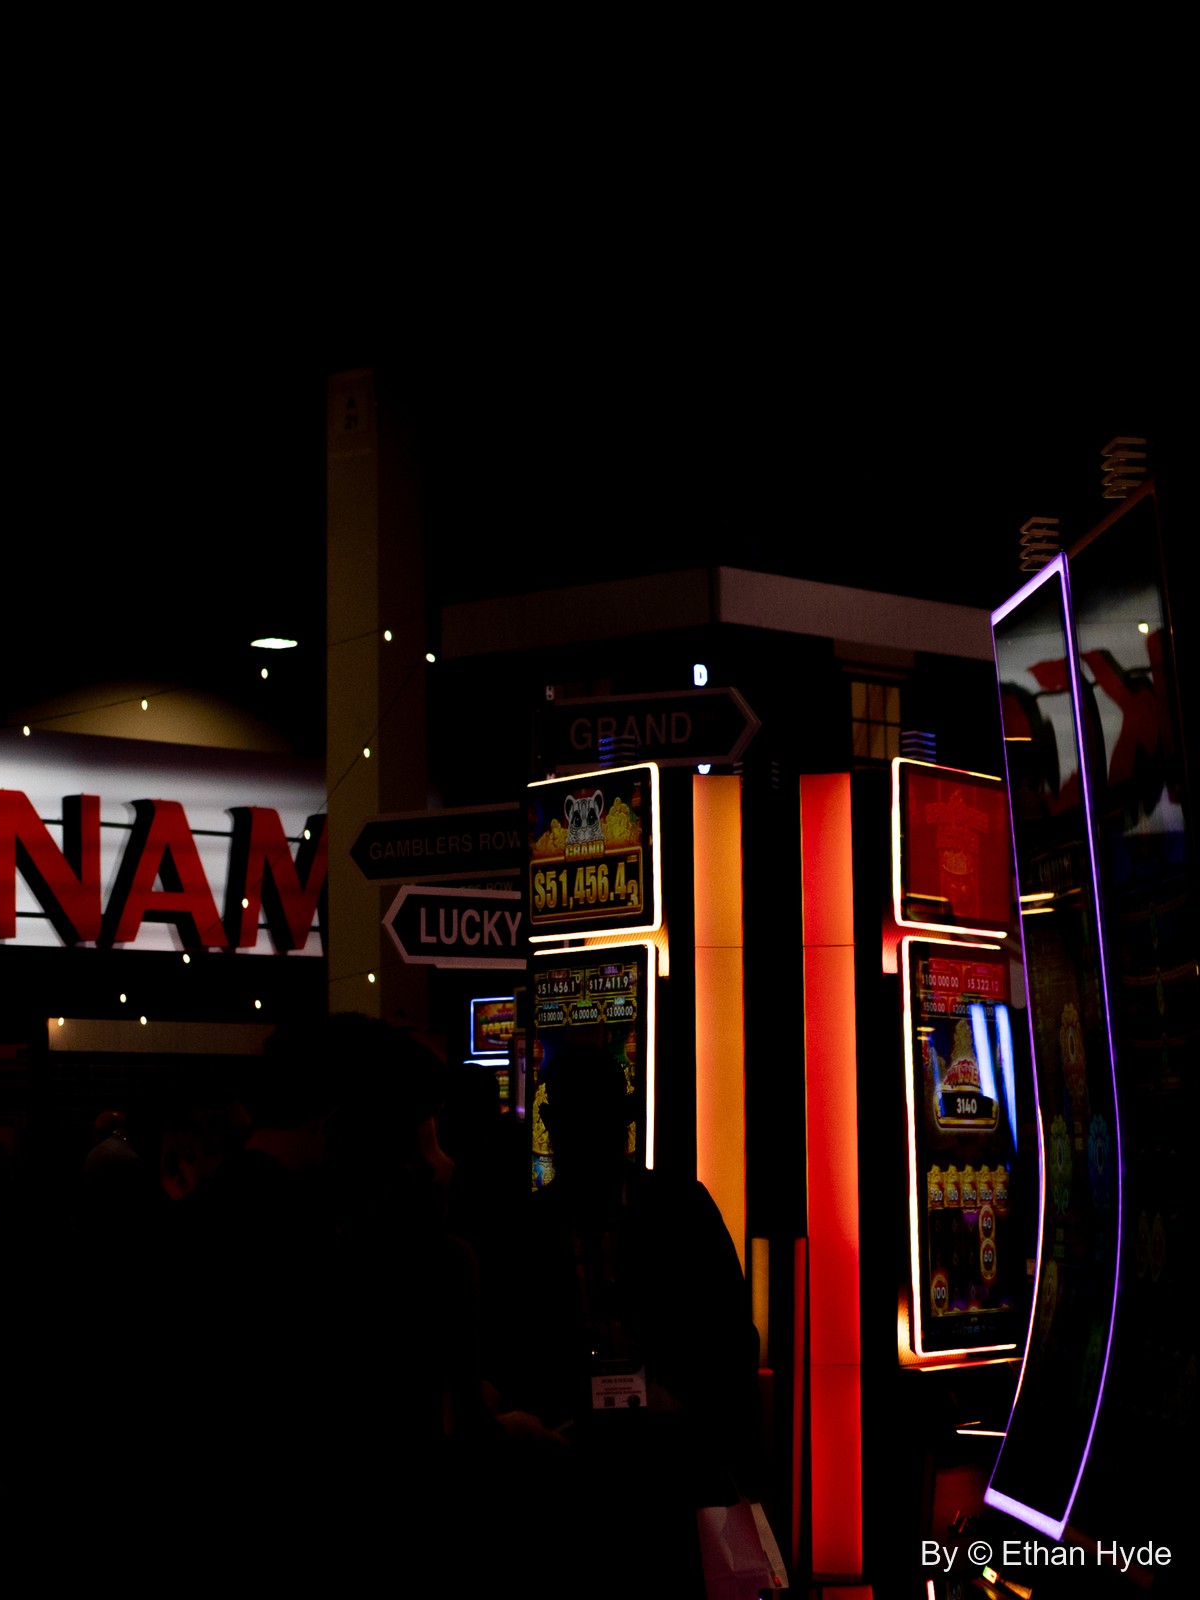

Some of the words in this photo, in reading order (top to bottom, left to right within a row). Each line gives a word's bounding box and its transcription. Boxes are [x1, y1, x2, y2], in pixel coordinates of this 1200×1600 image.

[569, 711, 694, 751] GRAND
[369, 833, 473, 861] GAMBLERS
[479, 830, 522, 851] ROW
[565, 840, 605, 857] GRAND
[420, 907, 523, 947] LUCKY
[956, 1098, 977, 1114] 3140
